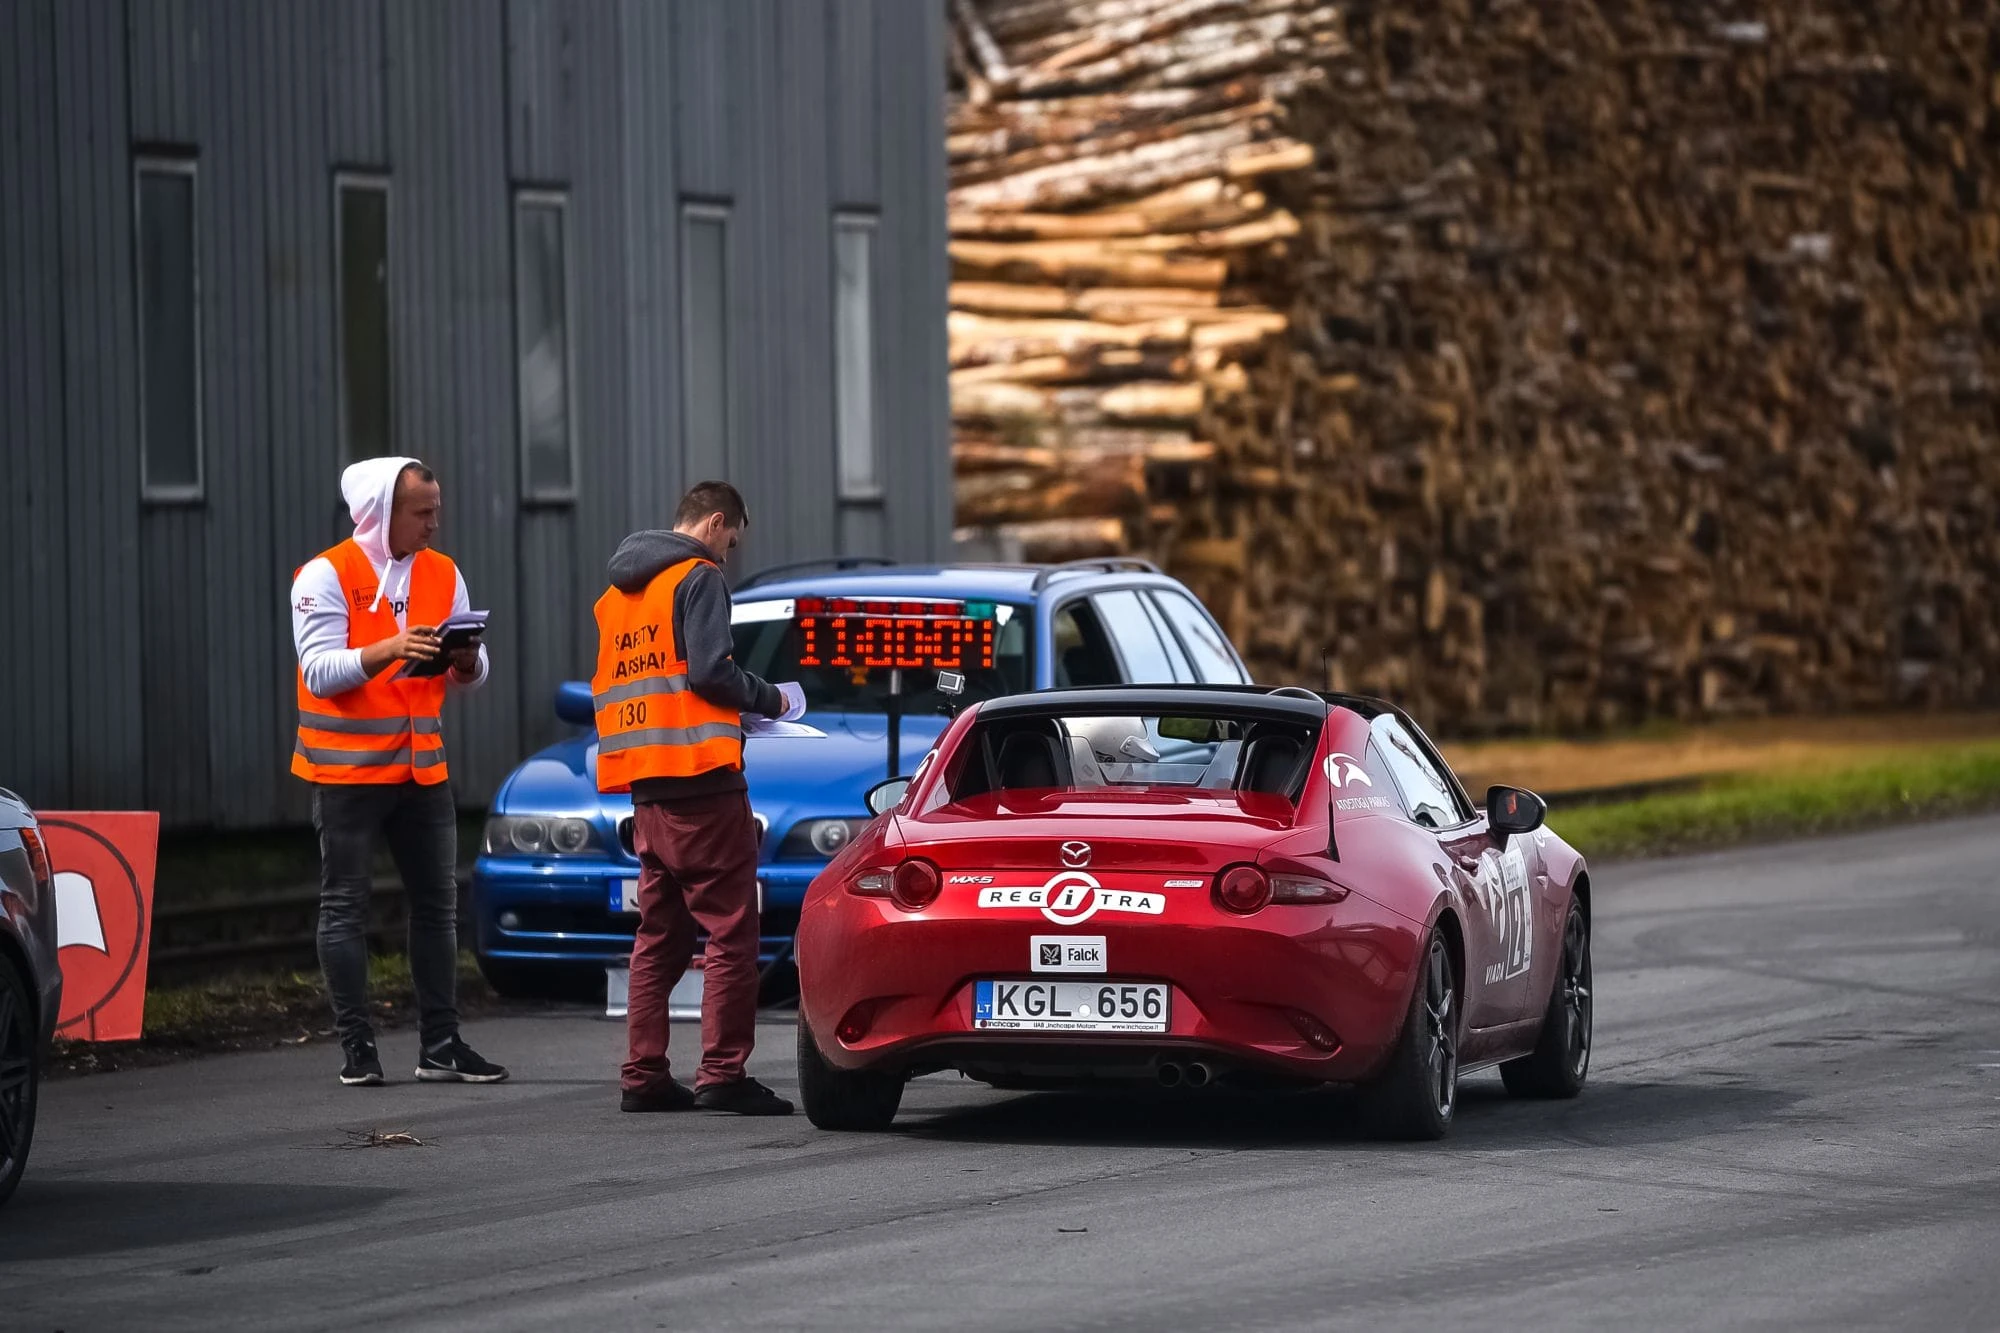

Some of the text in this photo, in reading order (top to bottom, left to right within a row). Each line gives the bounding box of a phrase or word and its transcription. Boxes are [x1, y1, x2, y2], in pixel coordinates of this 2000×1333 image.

[611, 651, 666, 679] ARSHA
[618, 701, 647, 728] 130
[949, 876, 995, 885] MX-5
[1068, 948, 1099, 961] Falck
[977, 1004, 991, 1013] LT
[997, 985, 1162, 1019] KGL 656
